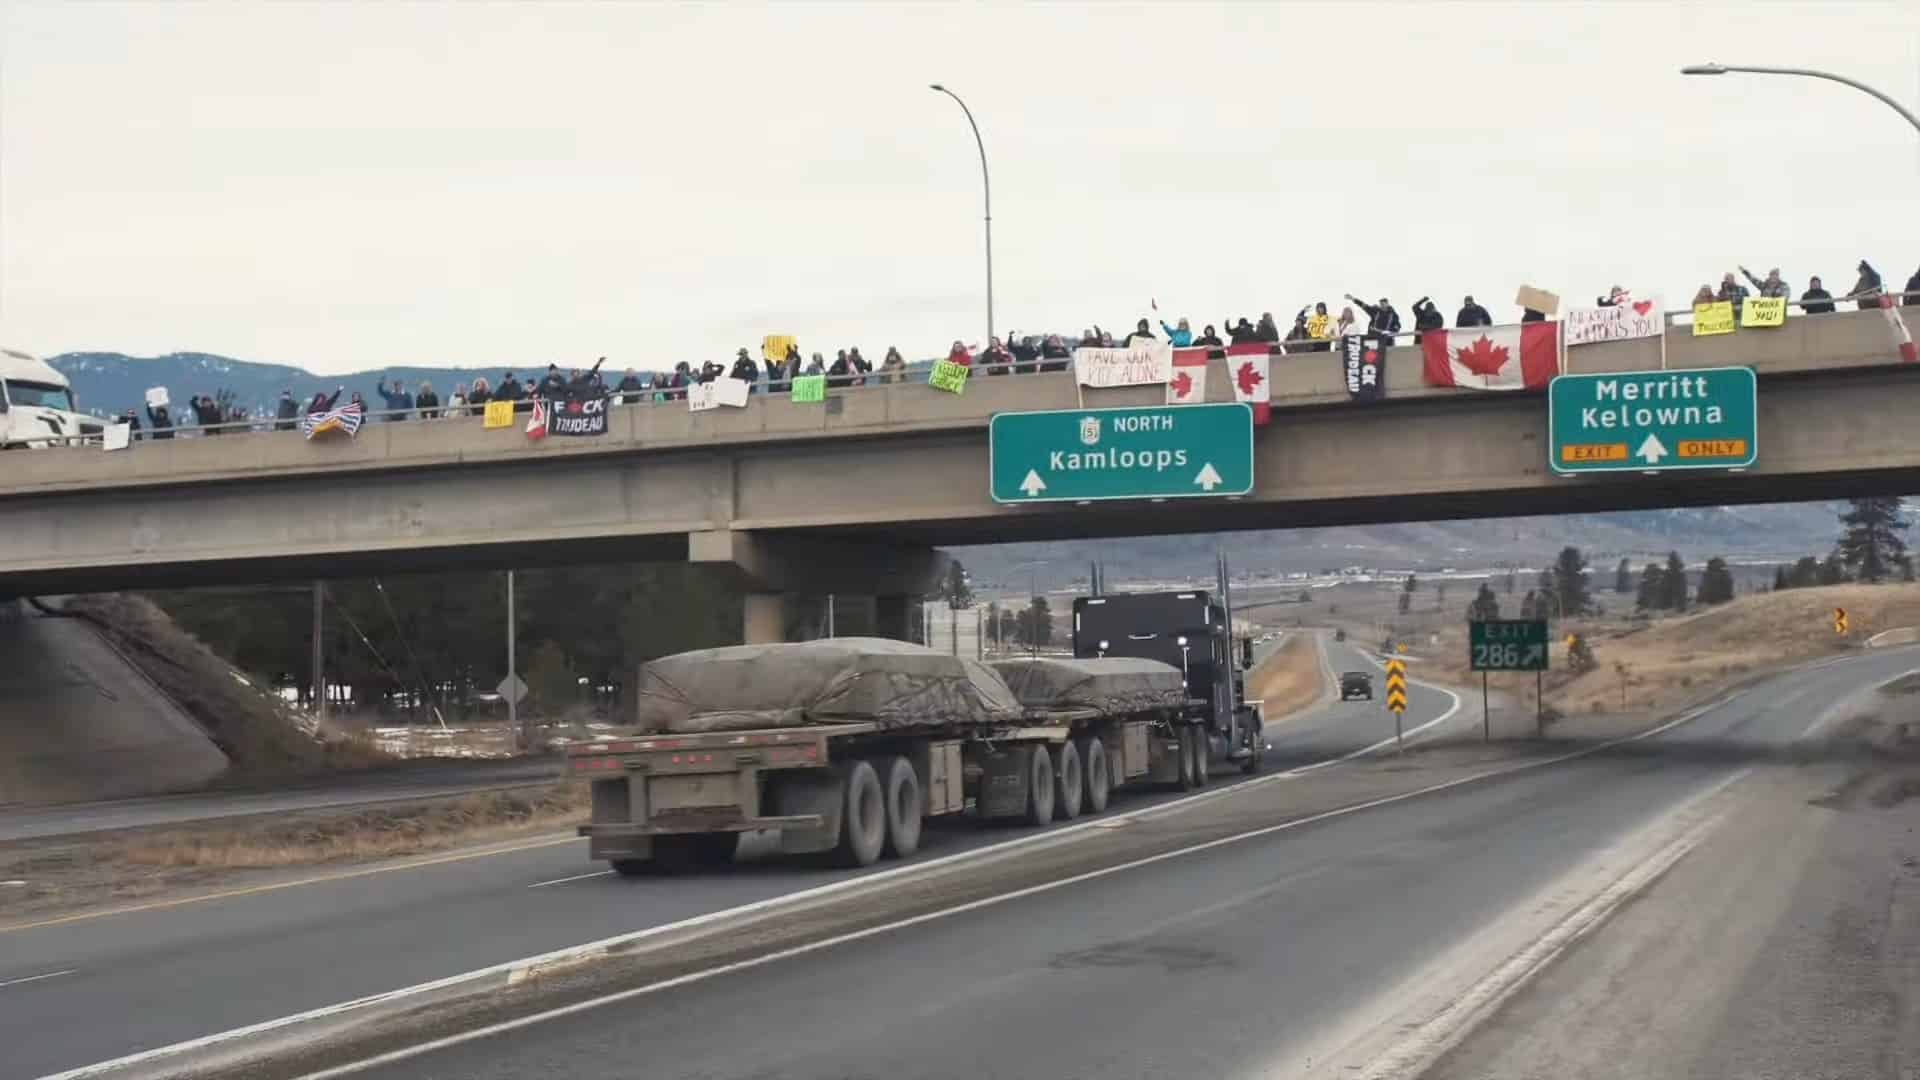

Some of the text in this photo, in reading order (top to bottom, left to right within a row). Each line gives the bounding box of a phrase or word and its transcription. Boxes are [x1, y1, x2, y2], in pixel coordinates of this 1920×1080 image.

[1347, 336, 1361, 392] TRUDEAU
[1362, 339, 1378, 385] FCK
[1596, 376, 1708, 401] Merritt
[554, 399, 605, 414] FCK
[1582, 405, 1722, 428] Kelowna
[556, 416, 603, 432] TRUDEAU
[1113, 415, 1173, 433] NORTH
[1050, 448, 1187, 472] Kamloops
[1574, 442, 1734, 459] EXIT ONLY
[1484, 623, 1530, 639] EXIT
[1474, 644, 1519, 667] 286
